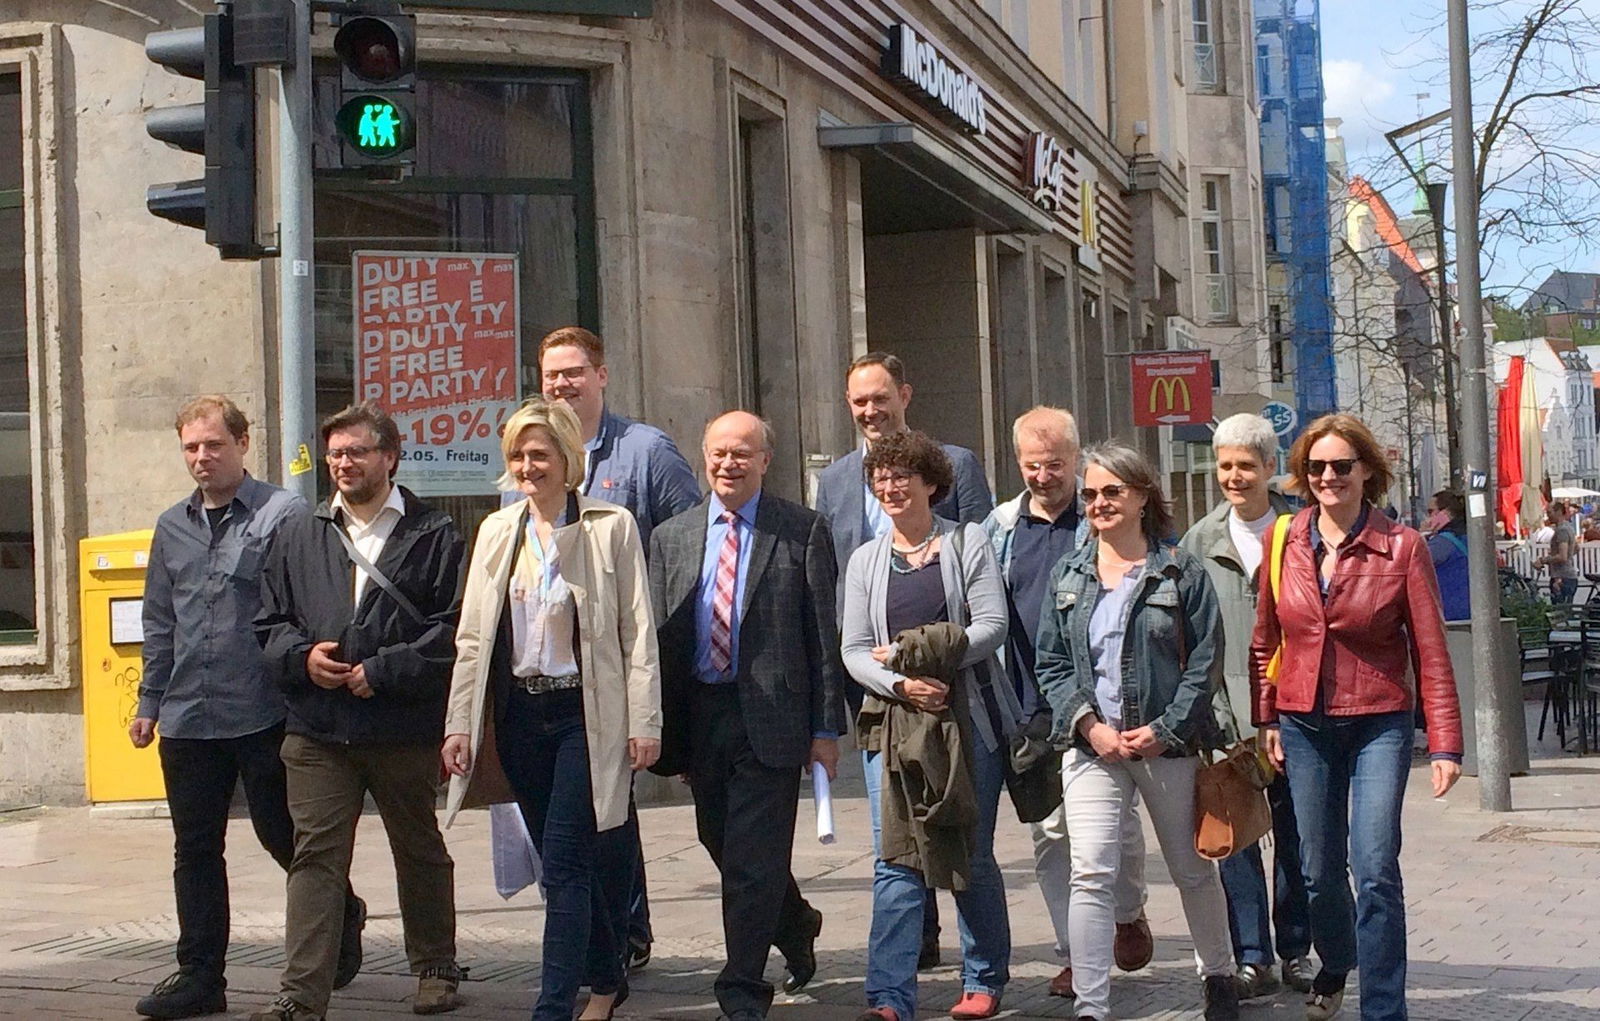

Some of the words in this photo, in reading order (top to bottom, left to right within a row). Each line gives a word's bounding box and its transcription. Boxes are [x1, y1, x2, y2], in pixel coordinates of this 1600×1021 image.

[902, 23, 986, 134] McDonald's
[363, 258, 439, 286] DUTY
[363, 279, 438, 312] FREE
[390, 323, 467, 352] DUTY
[390, 345, 464, 379] FREE
[390, 367, 487, 404] PARTY
[446, 450, 489, 465] Freitag
